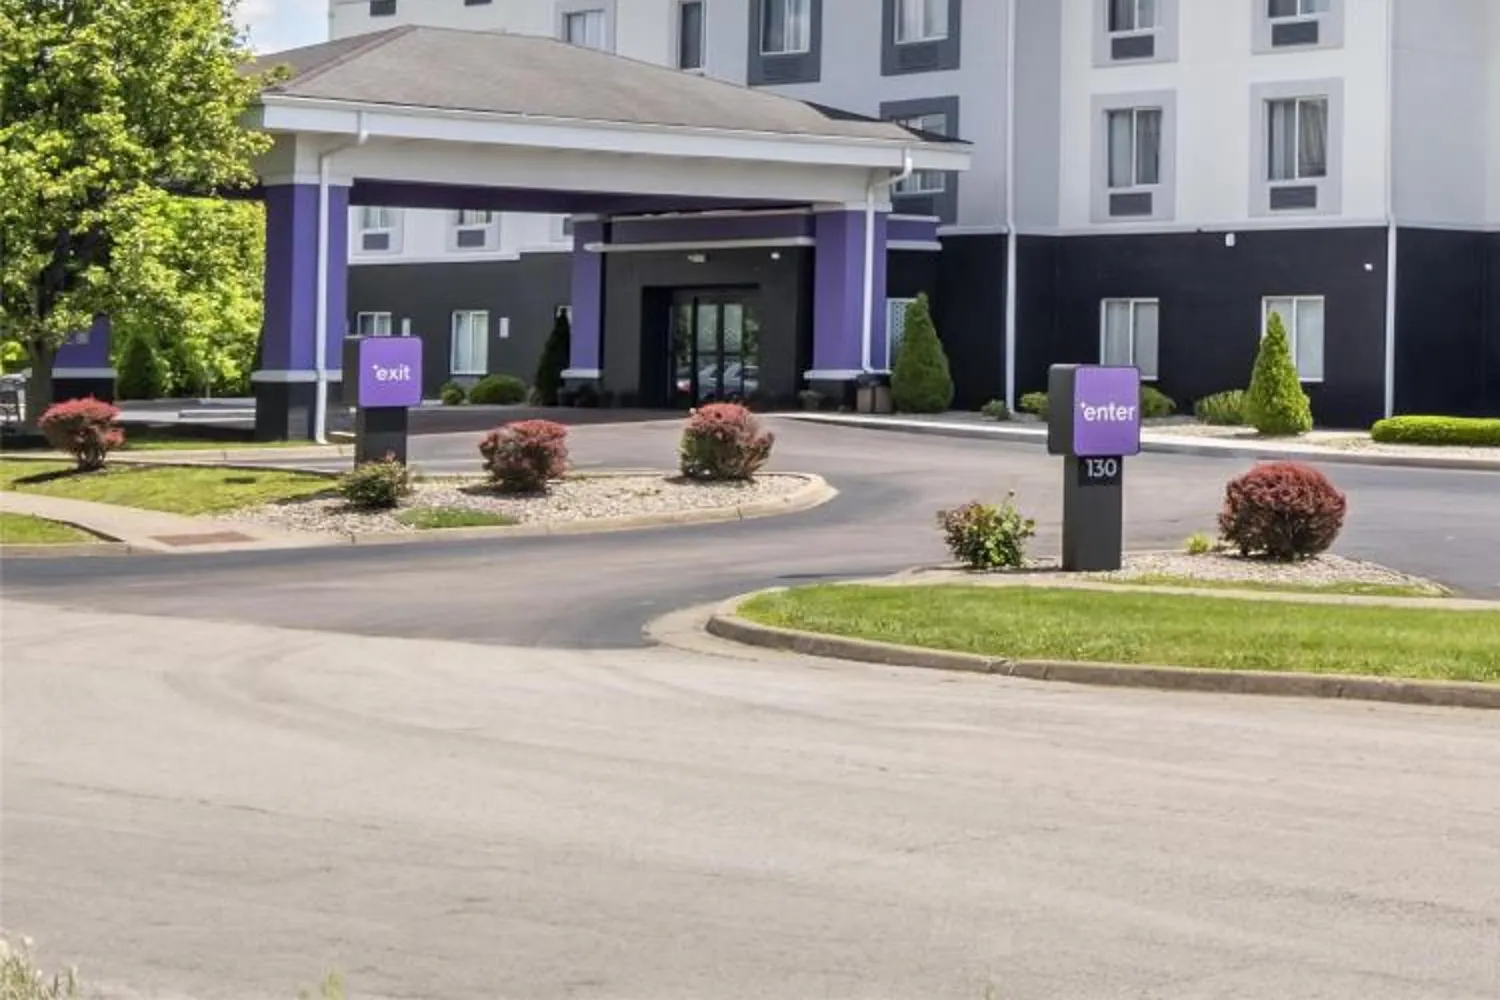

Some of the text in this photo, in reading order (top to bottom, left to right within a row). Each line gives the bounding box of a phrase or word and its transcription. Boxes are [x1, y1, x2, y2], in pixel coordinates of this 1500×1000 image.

[375, 363, 410, 381] exit
[1083, 402, 1136, 421] enter
[1086, 458, 1117, 477] 130
